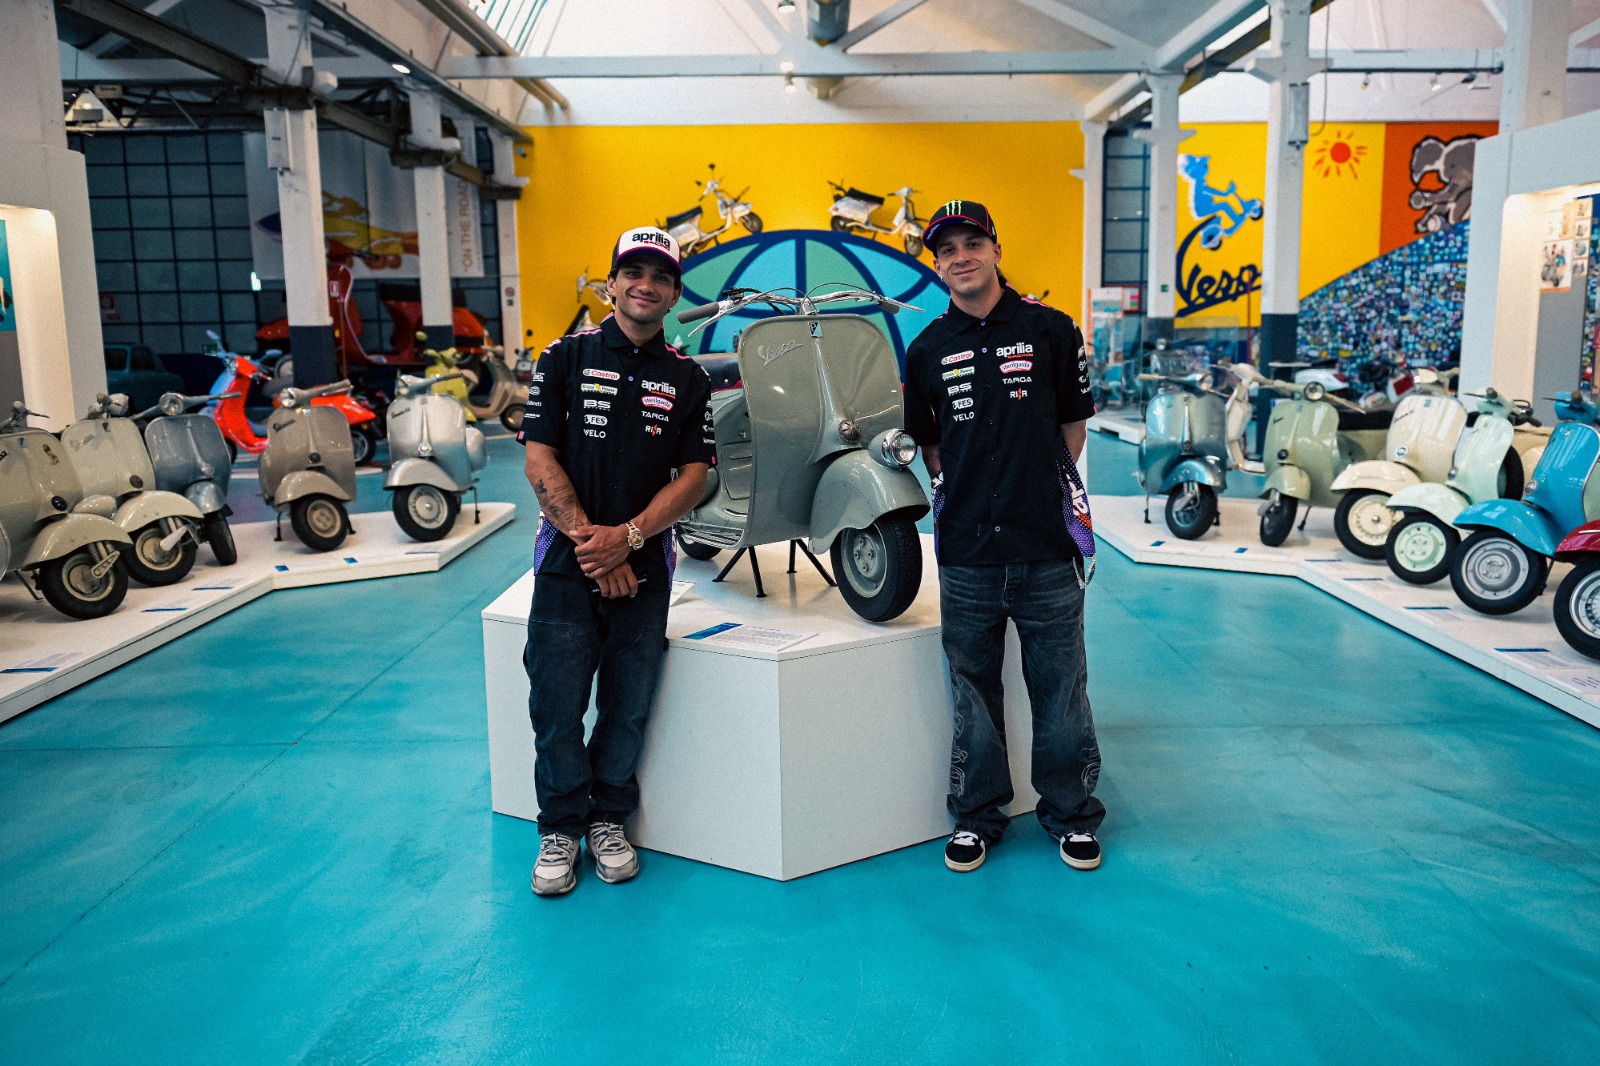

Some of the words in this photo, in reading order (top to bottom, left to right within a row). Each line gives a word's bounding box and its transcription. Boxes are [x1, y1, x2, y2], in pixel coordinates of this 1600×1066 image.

[460, 221, 472, 245] THE
[632, 232, 670, 248] aprilia
[1174, 232, 1262, 318] Vesp
[996, 342, 1034, 358] aprilia
[948, 351, 973, 363] Castrol
[591, 369, 619, 379] Castrol
[1002, 376, 1033, 385] TARGA
[641, 379, 676, 396] aprilia
[947, 382, 973, 394] BS
[583, 399, 611, 409] BS
[641, 410, 669, 422] TARGA
[953, 411, 975, 422] VELO
[583, 428, 606, 438] VELO
